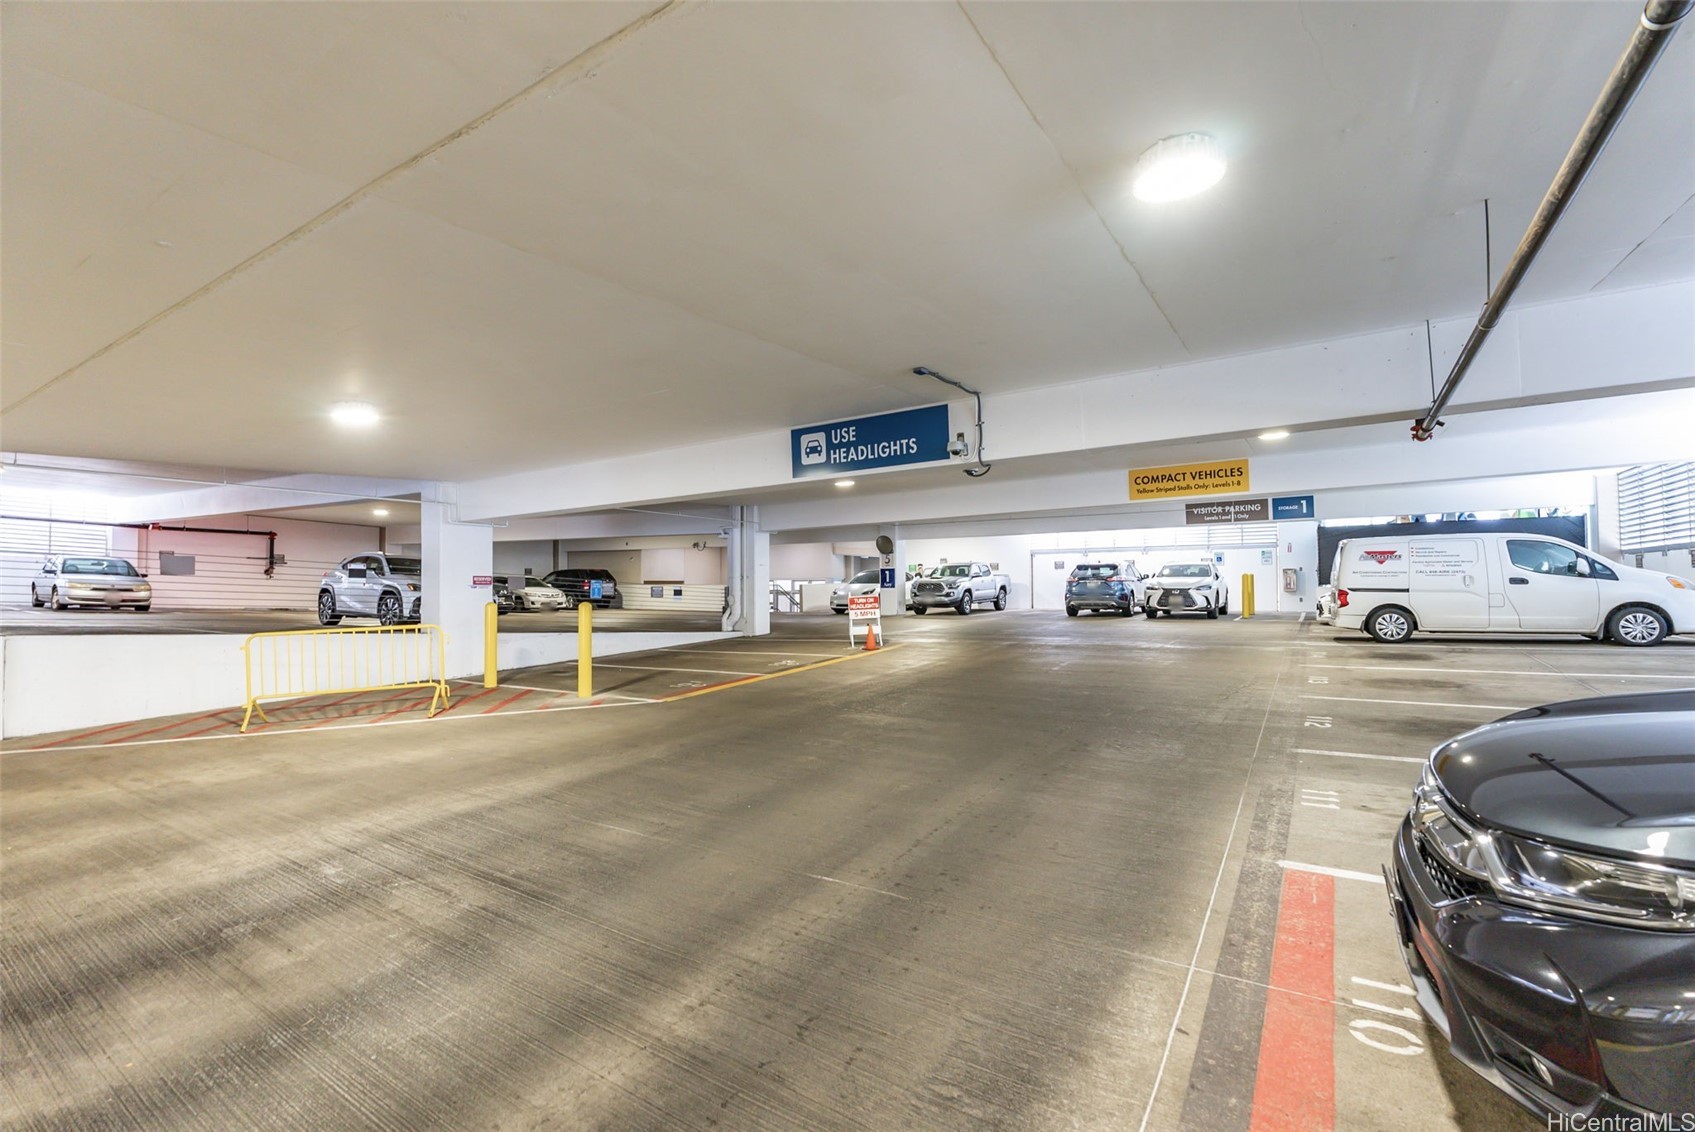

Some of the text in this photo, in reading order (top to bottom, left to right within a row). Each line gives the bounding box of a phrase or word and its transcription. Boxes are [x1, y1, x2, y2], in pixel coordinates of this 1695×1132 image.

[831, 426, 856, 444] USE
[830, 437, 918, 464] HEADLIGHTS
[1134, 467, 1243, 486] COMPACT VEHICLES
[1156, 485, 1176, 494] Striped
[1177, 484, 1193, 492] Stalls
[1194, 482, 1211, 492] Only:
[1212, 481, 1230, 489] Levels
[1193, 503, 1261, 515] VISITOR PARKING
[1300, 500, 1307, 514] 1
[884, 570, 890, 583] 1
[1301, 788, 1340, 810] 111
[1349, 976, 1425, 1056] 110
